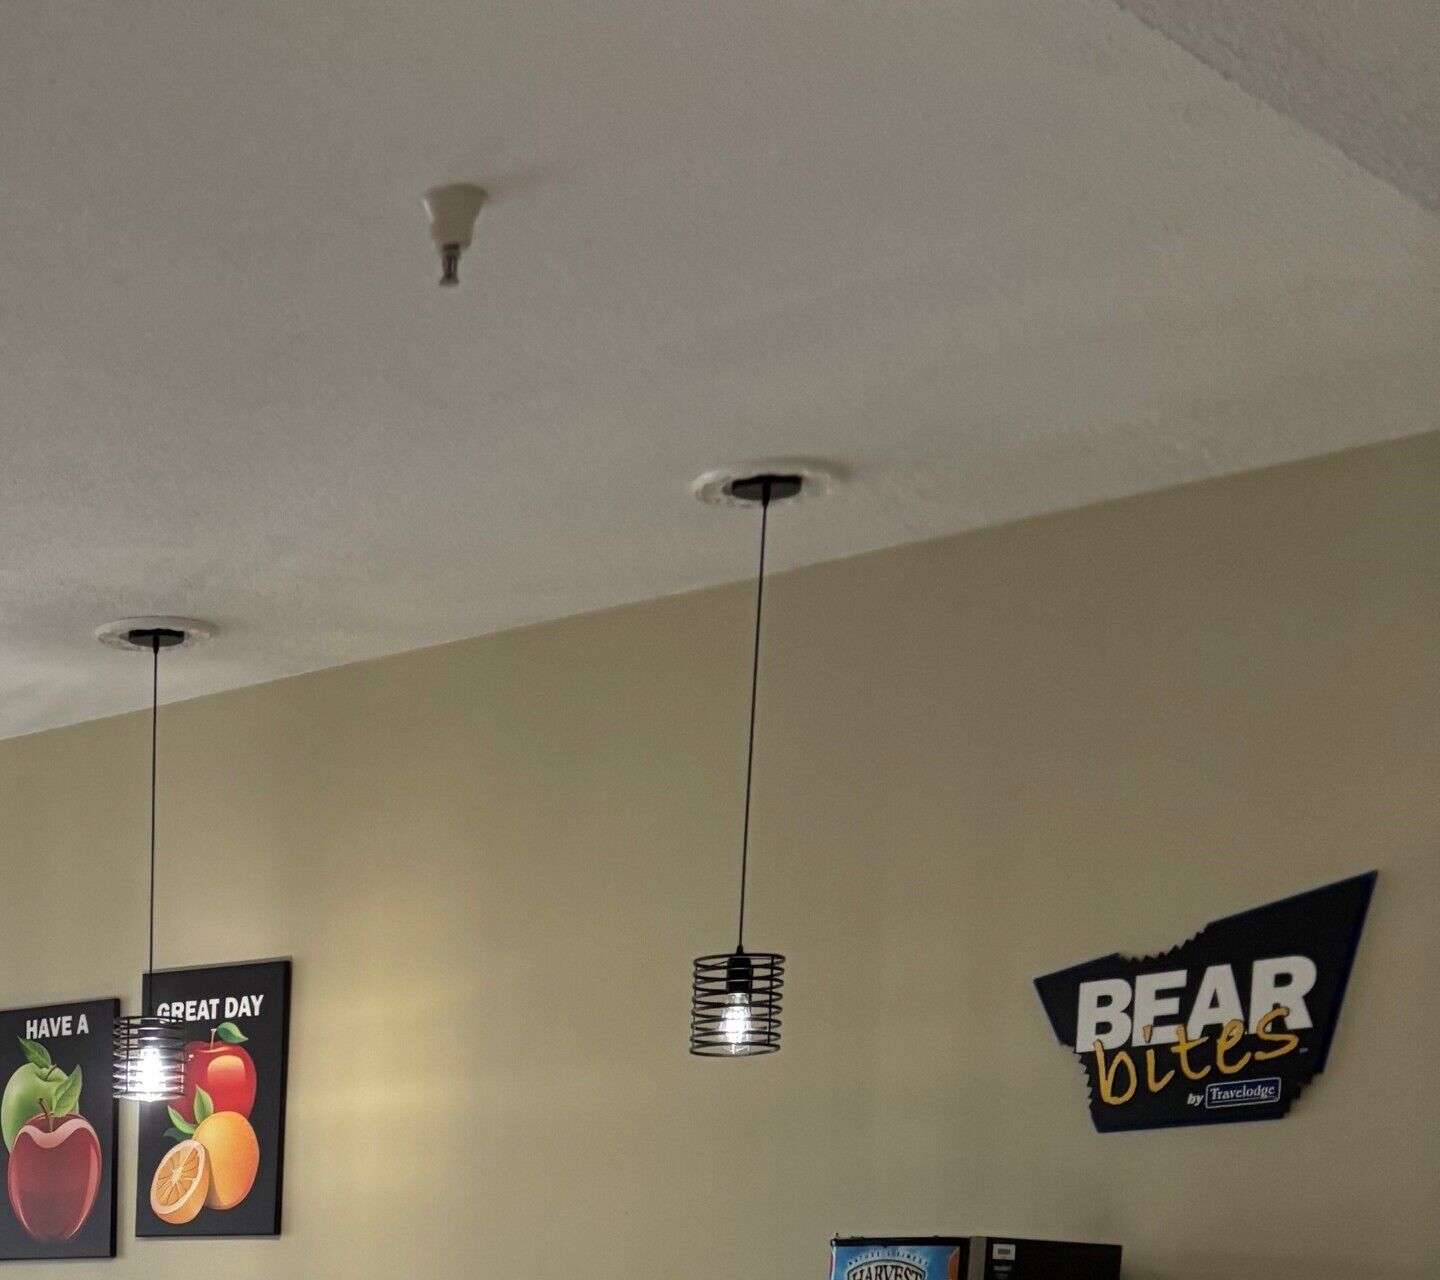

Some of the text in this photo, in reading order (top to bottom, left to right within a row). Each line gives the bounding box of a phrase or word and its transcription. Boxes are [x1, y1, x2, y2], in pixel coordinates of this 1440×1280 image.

[157, 994, 264, 1023] GREAT DAY
[1075, 955, 1317, 1054] BEAR
[25, 1014, 89, 1040] HAVE A
[1096, 1006, 1299, 1106] bites
[1186, 1083, 1276, 1107] by Travelodge
